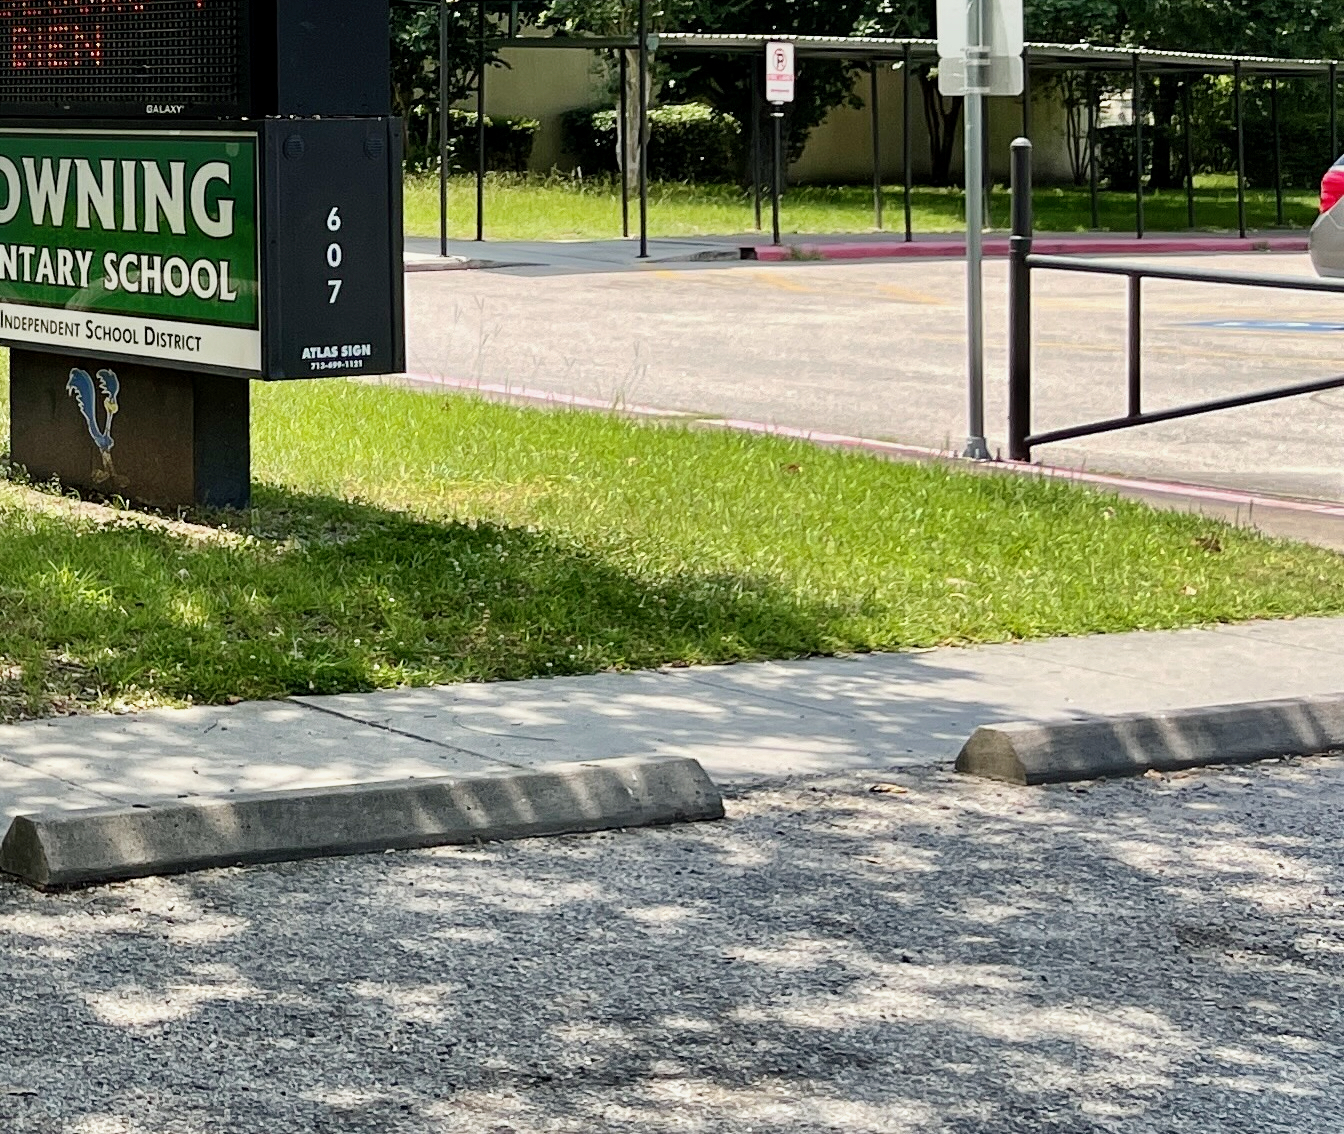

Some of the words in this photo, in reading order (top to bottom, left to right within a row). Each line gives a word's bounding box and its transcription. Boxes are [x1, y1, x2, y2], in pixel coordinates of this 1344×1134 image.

[13, 24, 102, 68] BIEN
[104, 252, 238, 302] SCHOOL
[302, 345, 339, 359] ATLAS
[341, 343, 371, 357] SIGN
